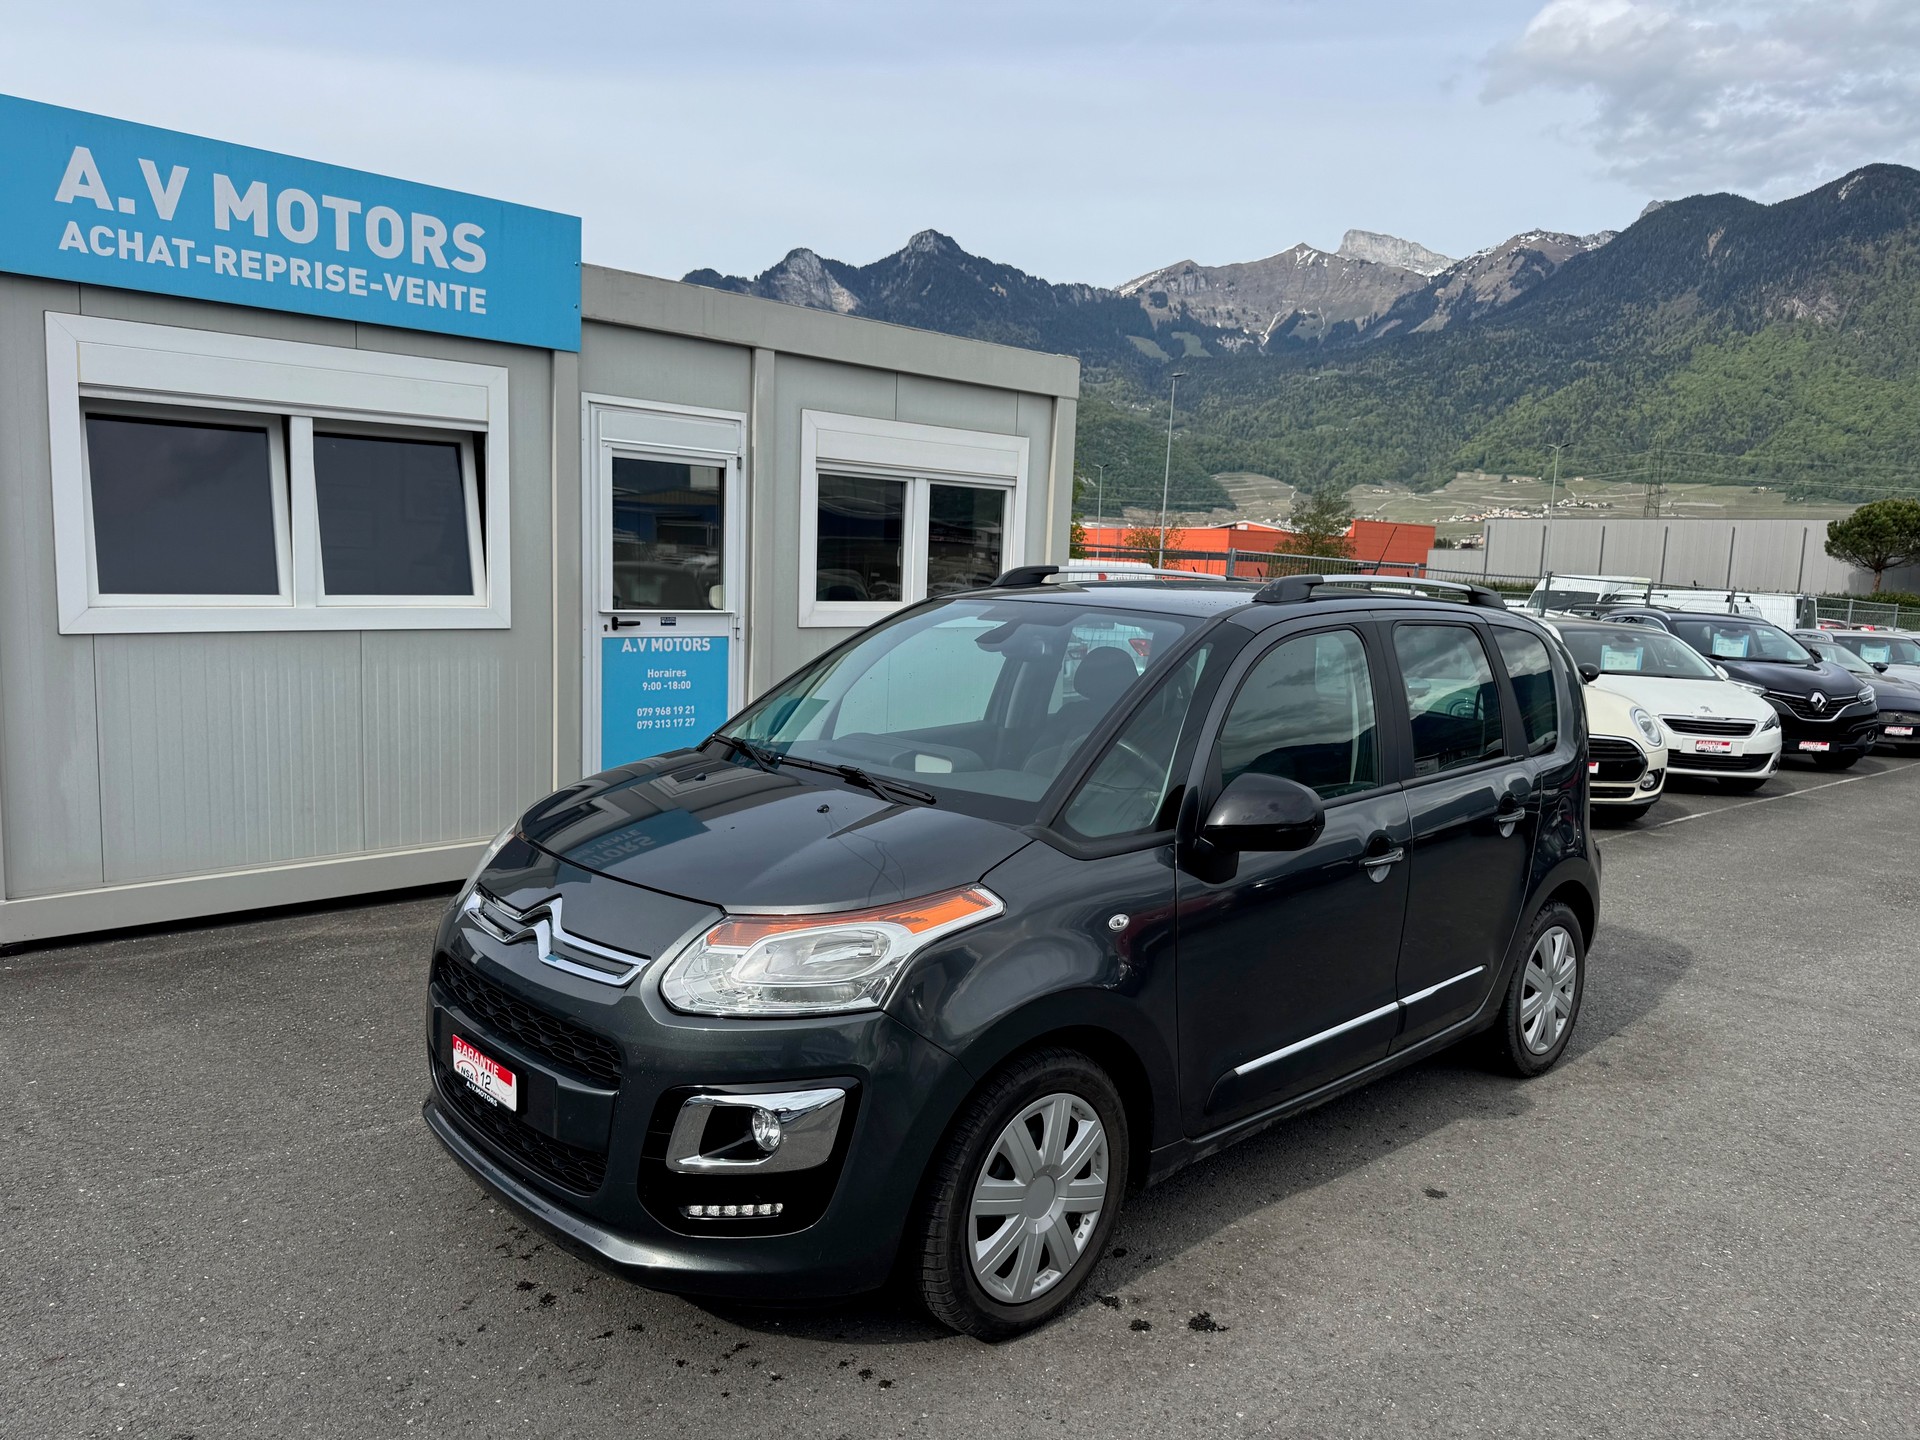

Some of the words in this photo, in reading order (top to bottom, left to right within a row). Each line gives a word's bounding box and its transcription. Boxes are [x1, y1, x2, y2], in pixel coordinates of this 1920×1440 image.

[54, 145, 190, 222] A.V
[213, 172, 488, 274] MOTORS
[58, 220, 488, 316] ACHAT-REPRISE-VENTE
[621, 638, 647, 652] A.V
[651, 637, 711, 652] MOTORS
[647, 668, 687, 678] Horaires
[636, 707, 653, 717] 079
[654, 706, 672, 716] 968
[673, 706, 684, 715] 19
[685, 705, 695, 714] 21
[636, 720, 653, 730] 079
[654, 719, 671, 729] 313
[673, 718, 683, 728] 17
[685, 717, 695, 728] 27
[455, 1040, 499, 1078] GARANTIE
[460, 1066, 474, 1081] NSA
[480, 1071, 492, 1091] 12
